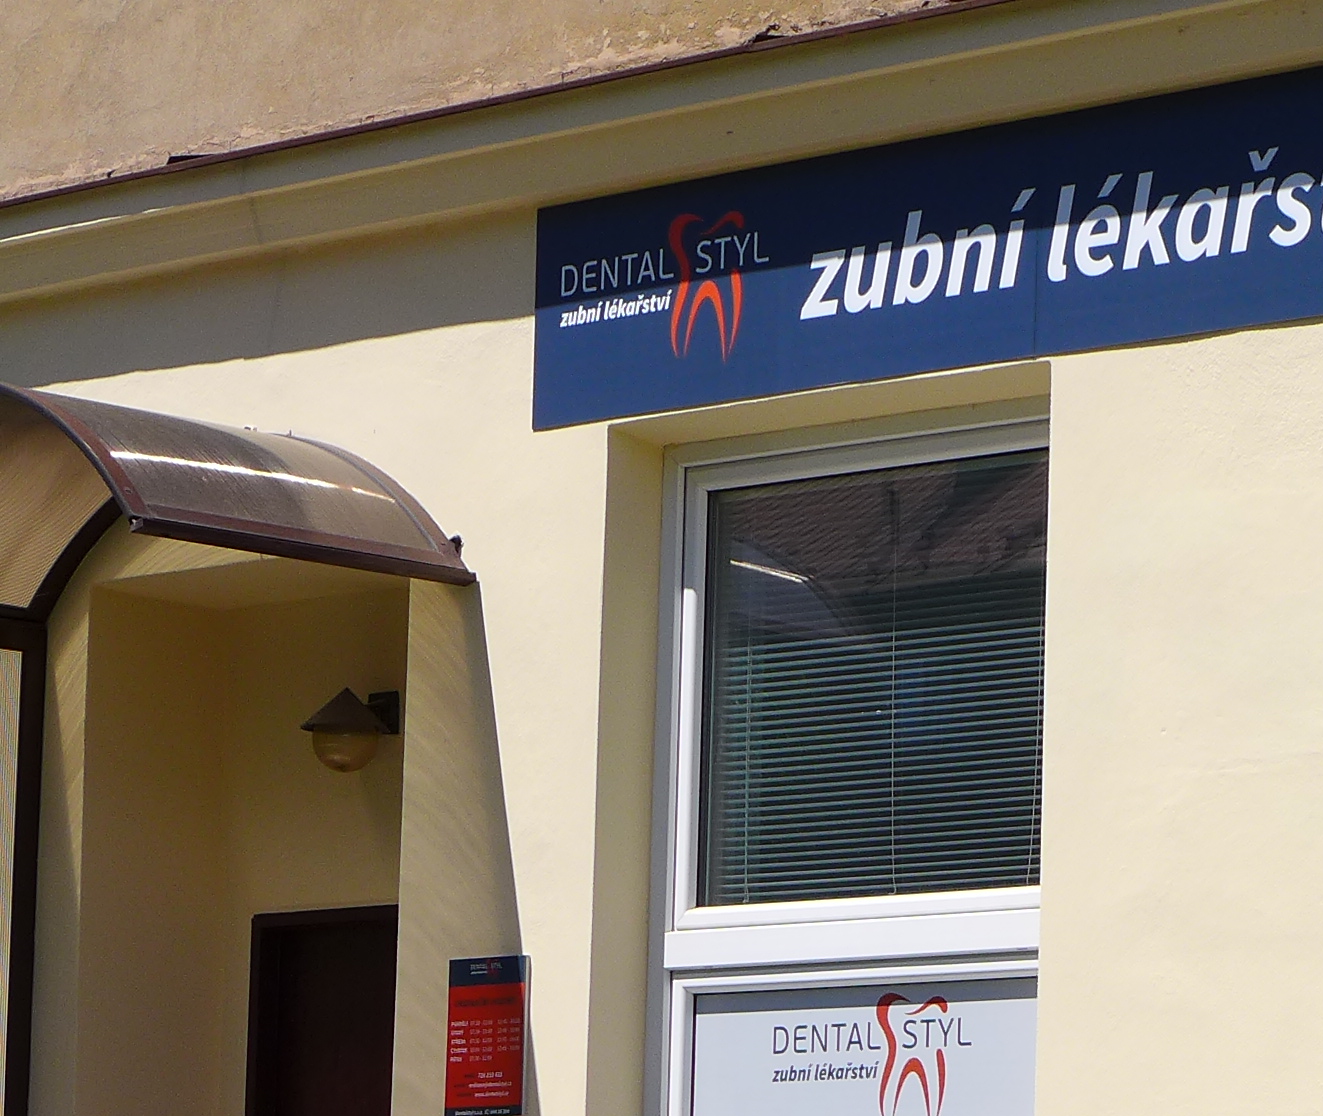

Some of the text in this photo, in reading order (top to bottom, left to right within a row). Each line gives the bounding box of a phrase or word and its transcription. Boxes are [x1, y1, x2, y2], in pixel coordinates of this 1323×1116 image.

[560, 231, 769, 297] DENTAL STYL
[799, 187, 1036, 320] zubní
[559, 289, 673, 328] zubní lékařství
[772, 1017, 972, 1054] DENTAL STYL
[772, 1060, 880, 1083] zubní lékařství
